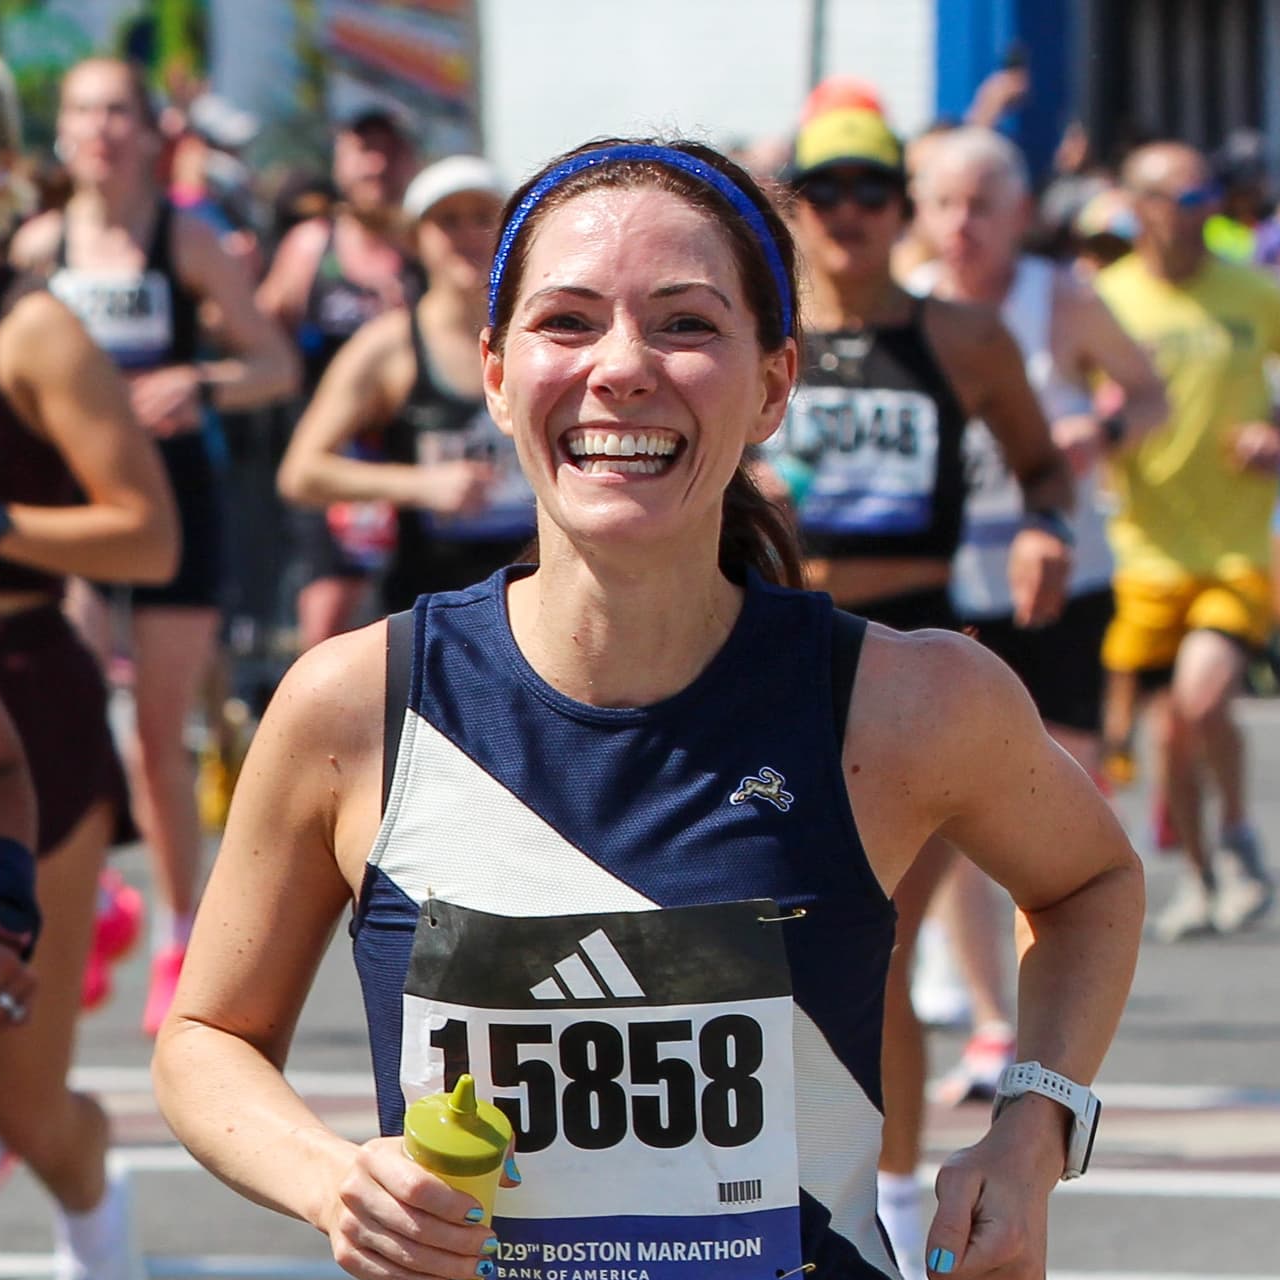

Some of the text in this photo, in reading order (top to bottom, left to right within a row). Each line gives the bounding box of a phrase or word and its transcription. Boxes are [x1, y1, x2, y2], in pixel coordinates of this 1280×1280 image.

[430, 1013, 764, 1154] 15858
[543, 1242, 631, 1263] BOSTON
[637, 1237, 762, 1262] MARATHON
[497, 1267, 650, 1280] BANK OF AMERICA
